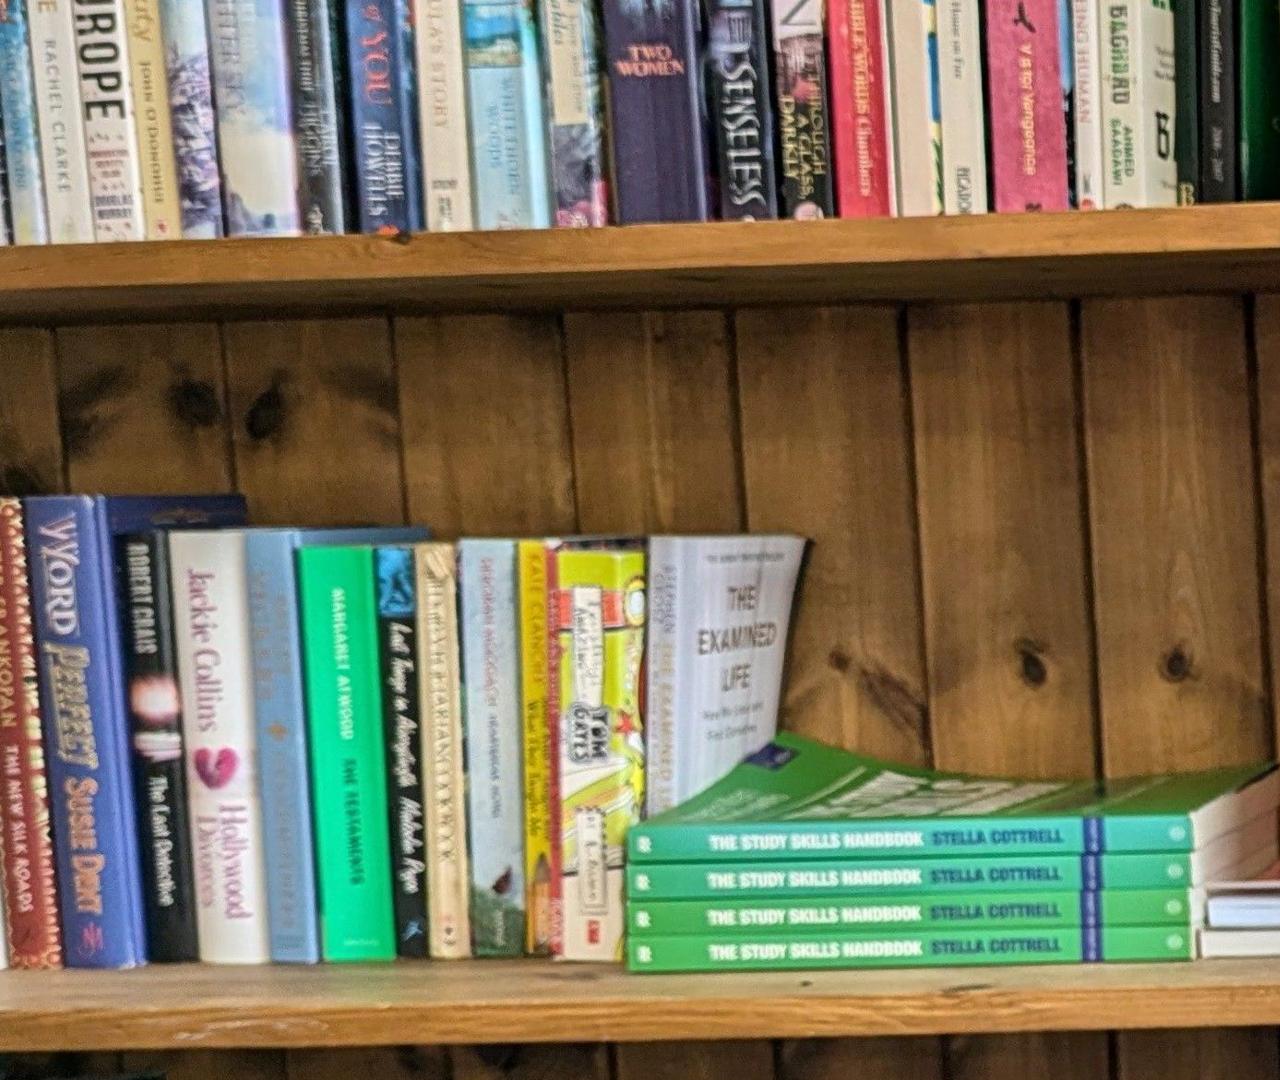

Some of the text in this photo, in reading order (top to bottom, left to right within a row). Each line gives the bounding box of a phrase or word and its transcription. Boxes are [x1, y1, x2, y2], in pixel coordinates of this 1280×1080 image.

[75, 0, 126, 121] ROPE
[360, 31, 393, 106] YOU
[614, 60, 686, 77] WOMEN
[628, 44, 673, 60] TWO
[1020, 43, 1034, 55] V
[44, 39, 71, 192] RACHEL CLARKE
[721, 60, 766, 206] SENSELESS
[1022, 93, 1037, 176] Vengeance
[362, 122, 388, 217] HOWELLS
[1124, 126, 1136, 177] AHMED
[126, 542, 153, 604] ROBERT
[727, 583, 759, 611] THE
[38, 511, 98, 771] WORD PERFECT
[187, 568, 225, 733] Jackie Collins
[330, 587, 354, 740] MARGARET ATWOOD
[698, 621, 777, 655] EXAMINED
[721, 663, 752, 692] LIFE
[573, 708, 591, 761] GATES
[591, 712, 609, 758] TOM
[148, 776, 169, 803] The
[64, 777, 105, 916] SUSIE DENT
[220, 804, 255, 919] Hollywood
[709, 828, 1064, 851] THE STUDY SKILLS HANDBOOK STELLA COTTRELL
[707, 866, 1063, 890] THE STUDY SKILLS HANDBOOK STELLA COTTRELL
[707, 903, 1062, 926] THE STUDY SKILLS HANDBOOK STELLA COTTRELL
[709, 938, 1063, 961] THE STUDY SKILLS HANDBOOK STELLA COTTRELL
